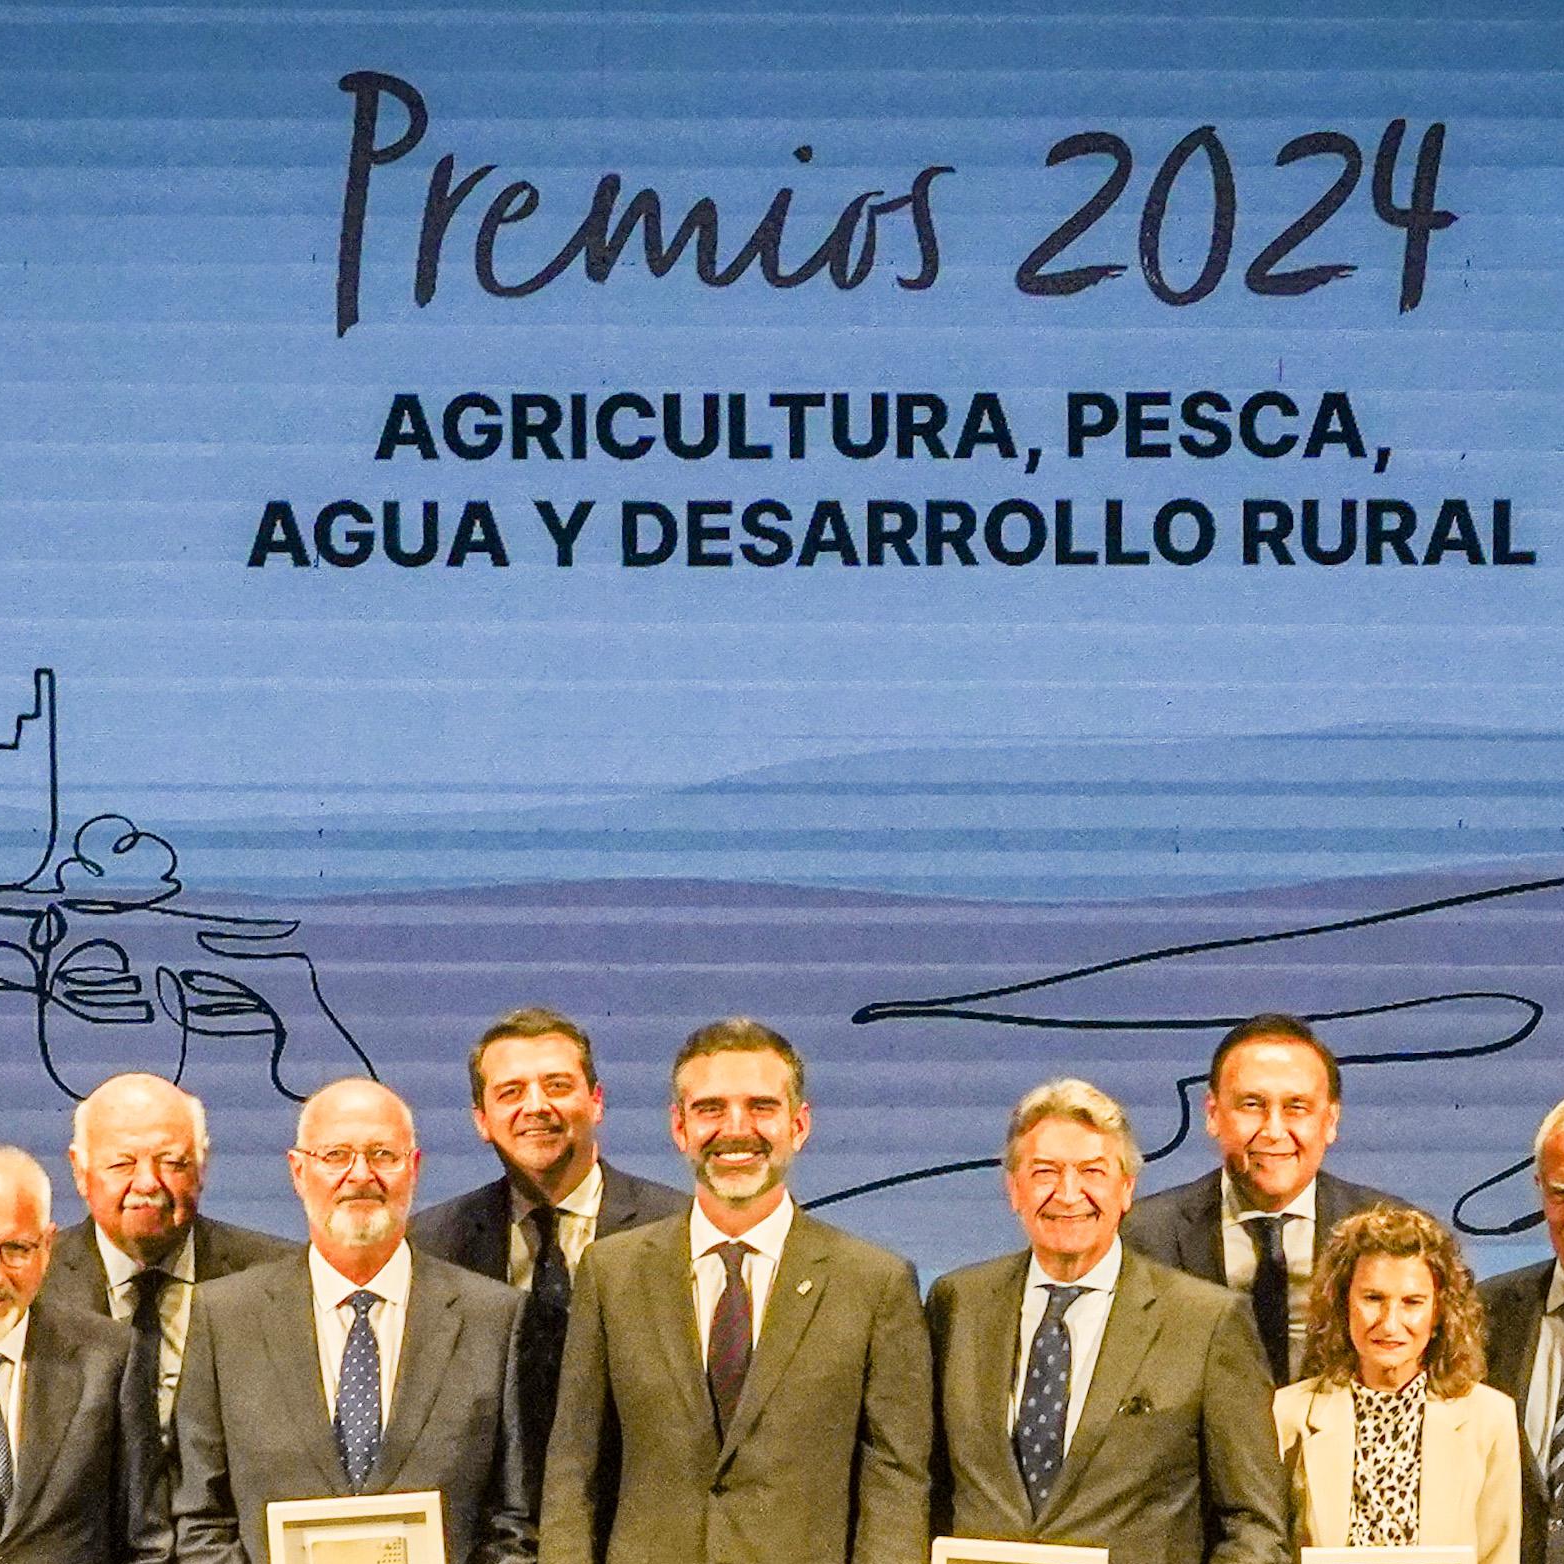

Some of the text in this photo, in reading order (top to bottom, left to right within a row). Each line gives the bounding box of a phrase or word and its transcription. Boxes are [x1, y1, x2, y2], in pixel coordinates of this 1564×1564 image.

[337, 70, 1459, 337] Premios 2024
[375, 390, 1391, 474] AGRICULTURA, PESCA,
[248, 499, 1536, 568] AGUA Y DESARROLLO RURAL
